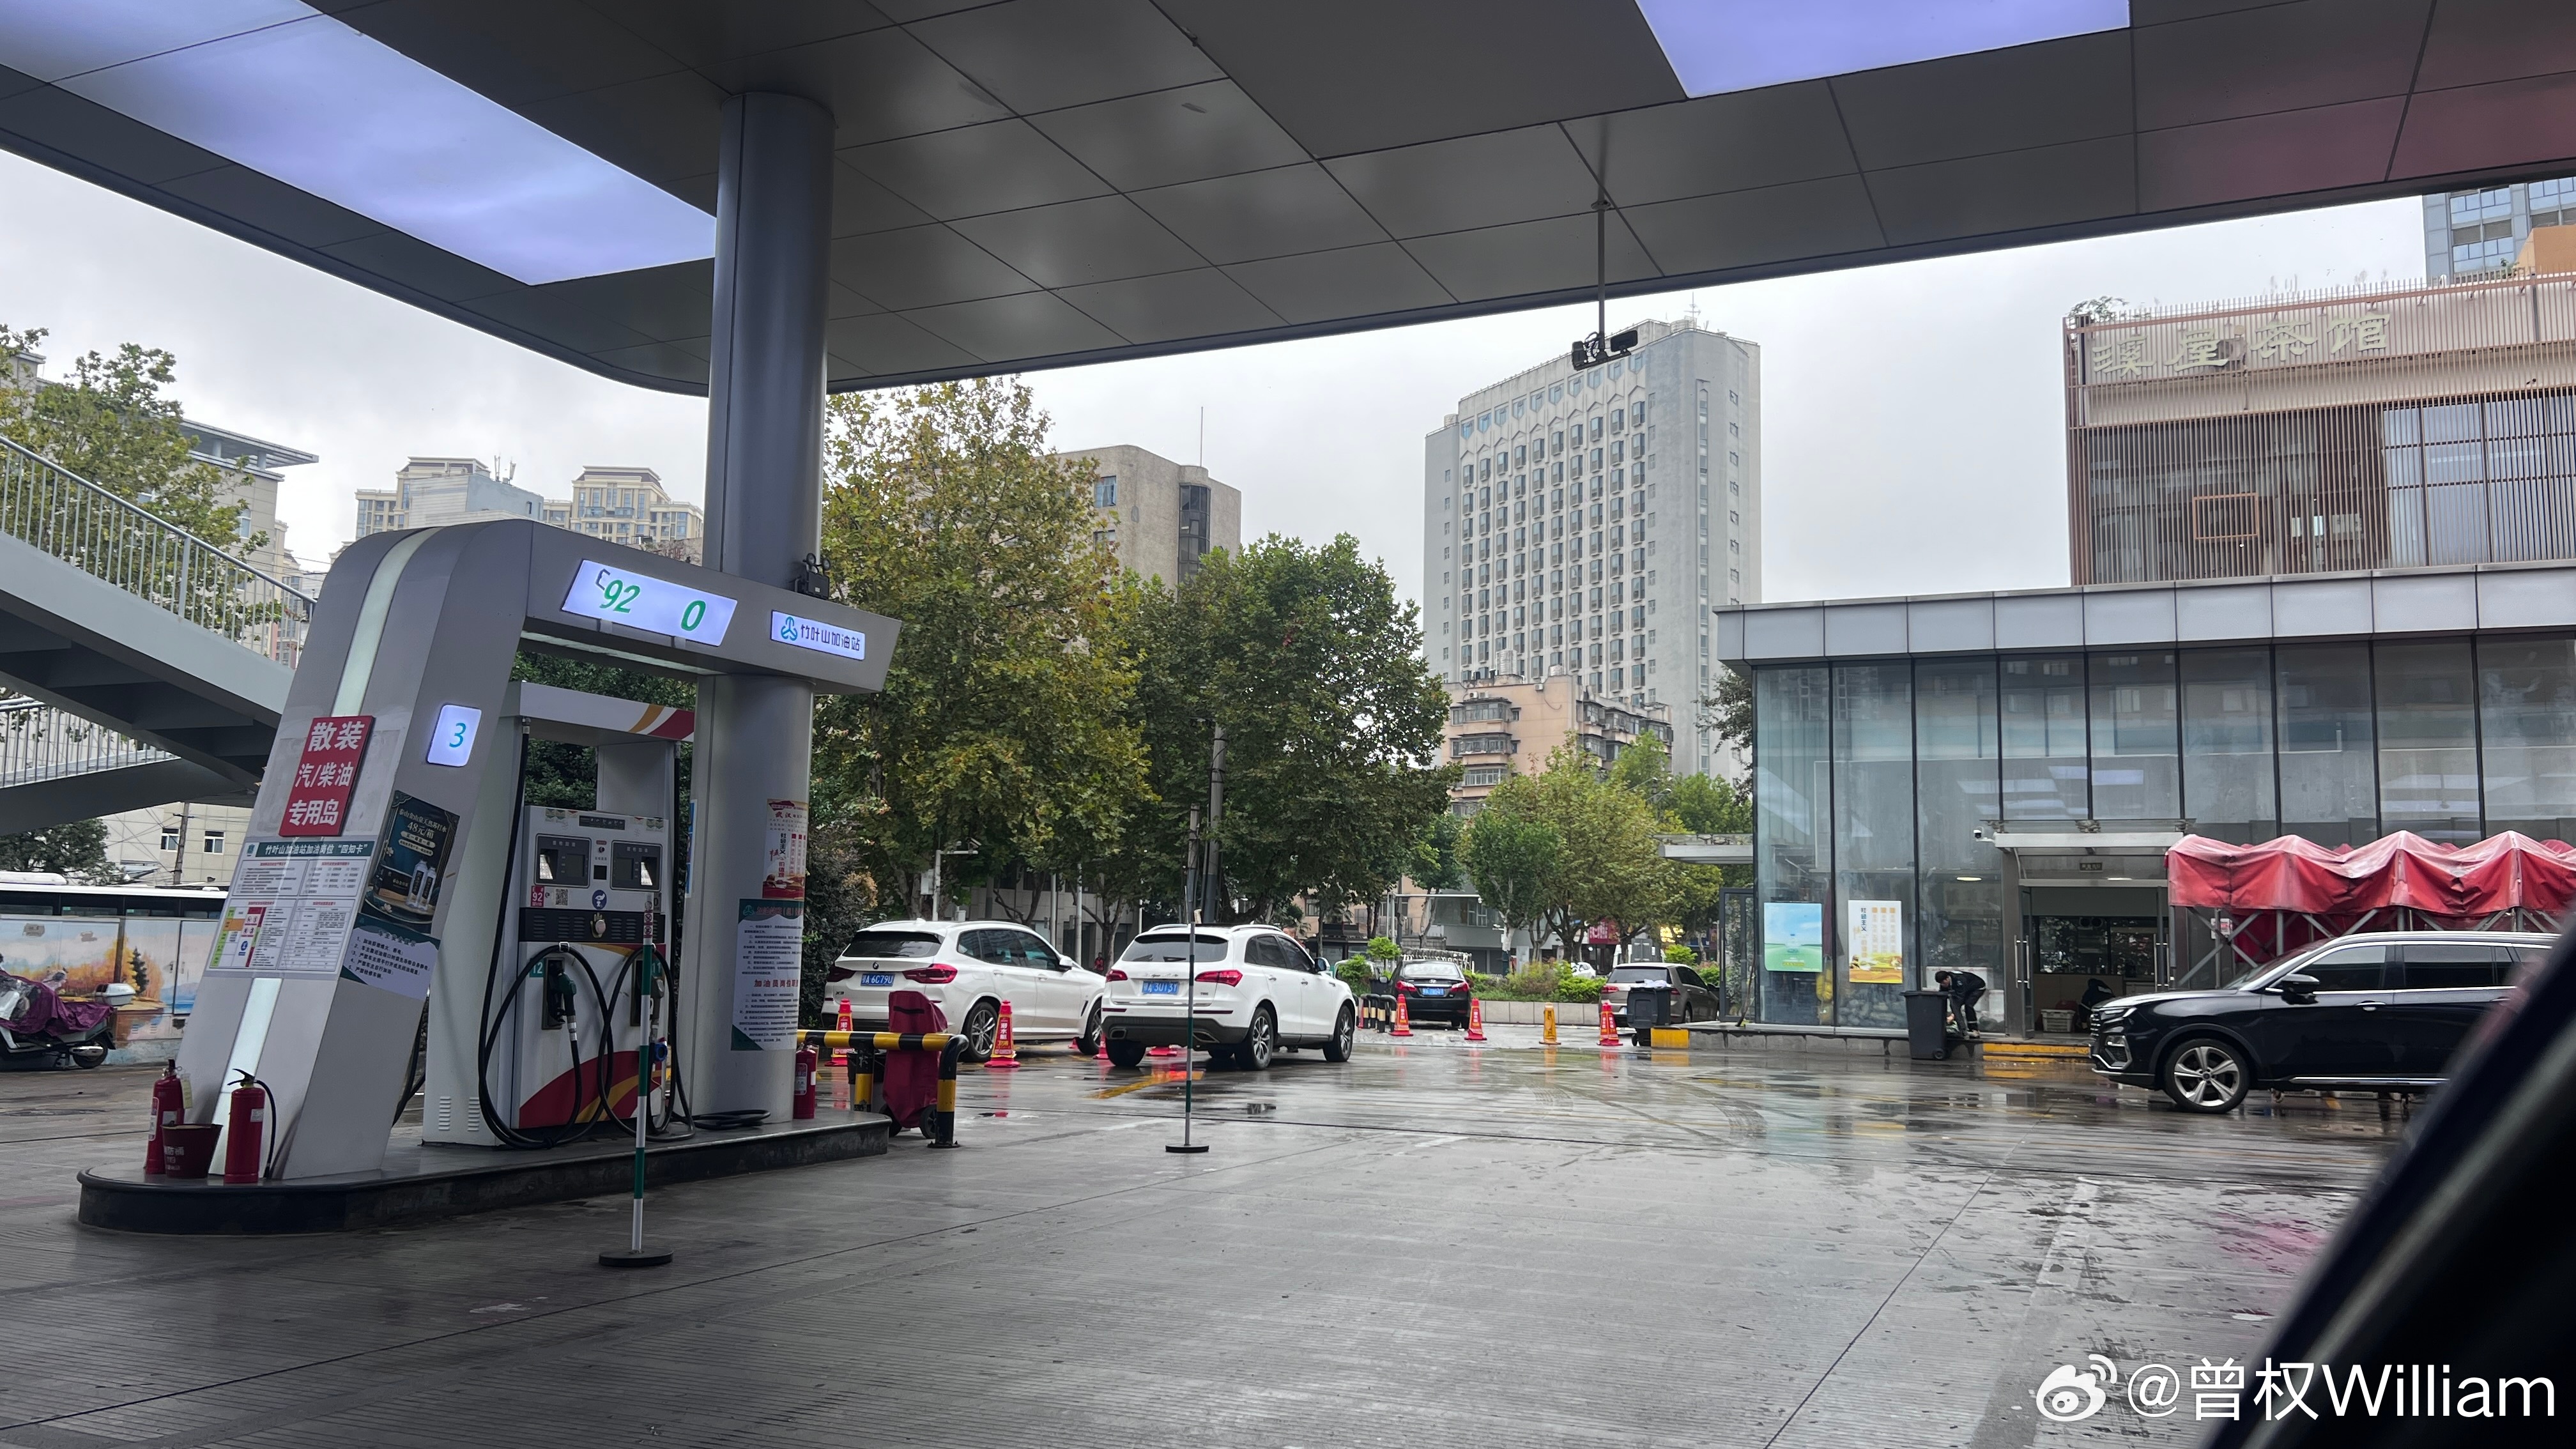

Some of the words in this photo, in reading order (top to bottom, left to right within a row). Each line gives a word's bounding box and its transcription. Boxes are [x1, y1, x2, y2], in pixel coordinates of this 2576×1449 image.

[680, 600, 707, 631] 0
[801, 624, 861, 652] 竹叶山加油站
[307, 721, 365, 752] 散装
[448, 722, 466, 749] 3
[295, 761, 354, 788] 汽/柴油
[289, 799, 339, 826] 专用岛
[532, 892, 543, 901] 92
[533, 962, 543, 974] 12
[652, 962, 661, 973] 11
